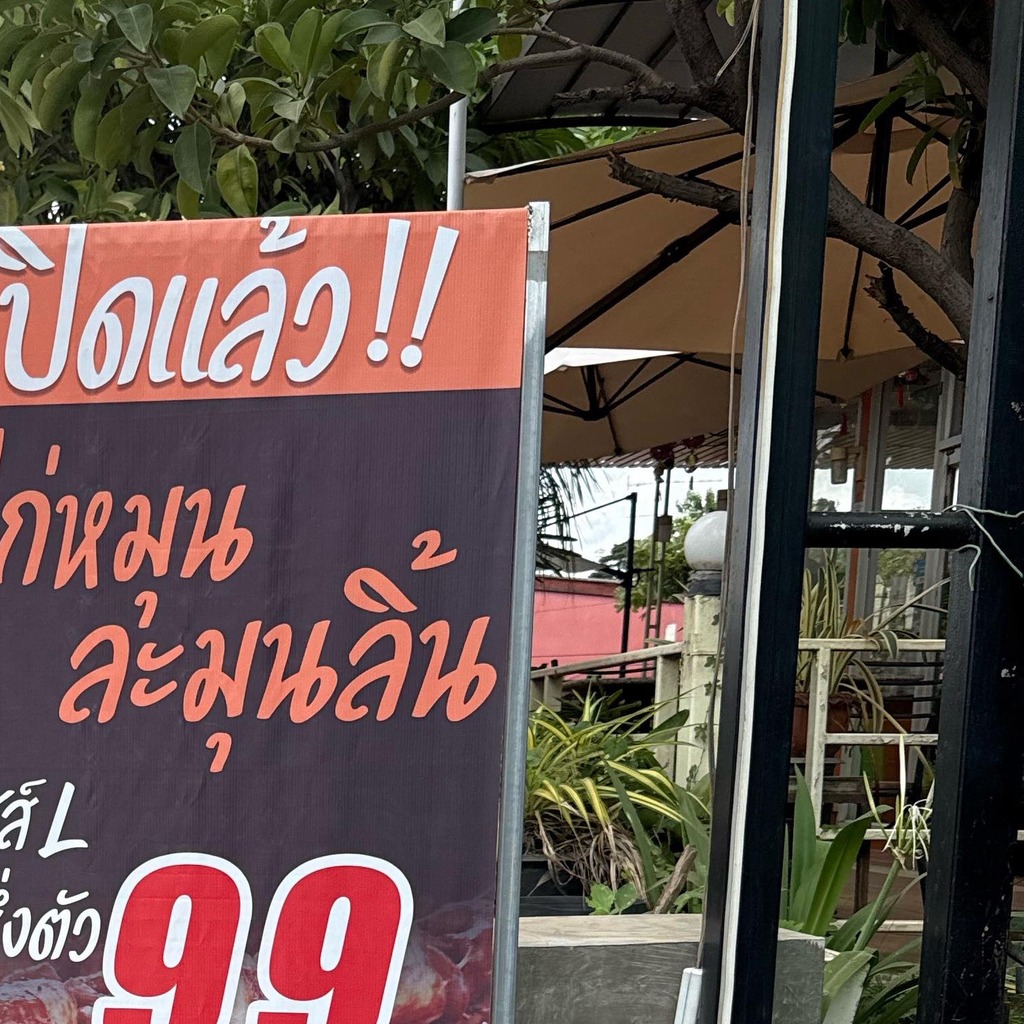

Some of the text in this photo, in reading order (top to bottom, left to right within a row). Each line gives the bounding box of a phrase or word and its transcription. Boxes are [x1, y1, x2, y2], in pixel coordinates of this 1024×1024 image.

[59, 530, 497, 772] ละมุนลิ้น
[38, 781, 89, 859] L
